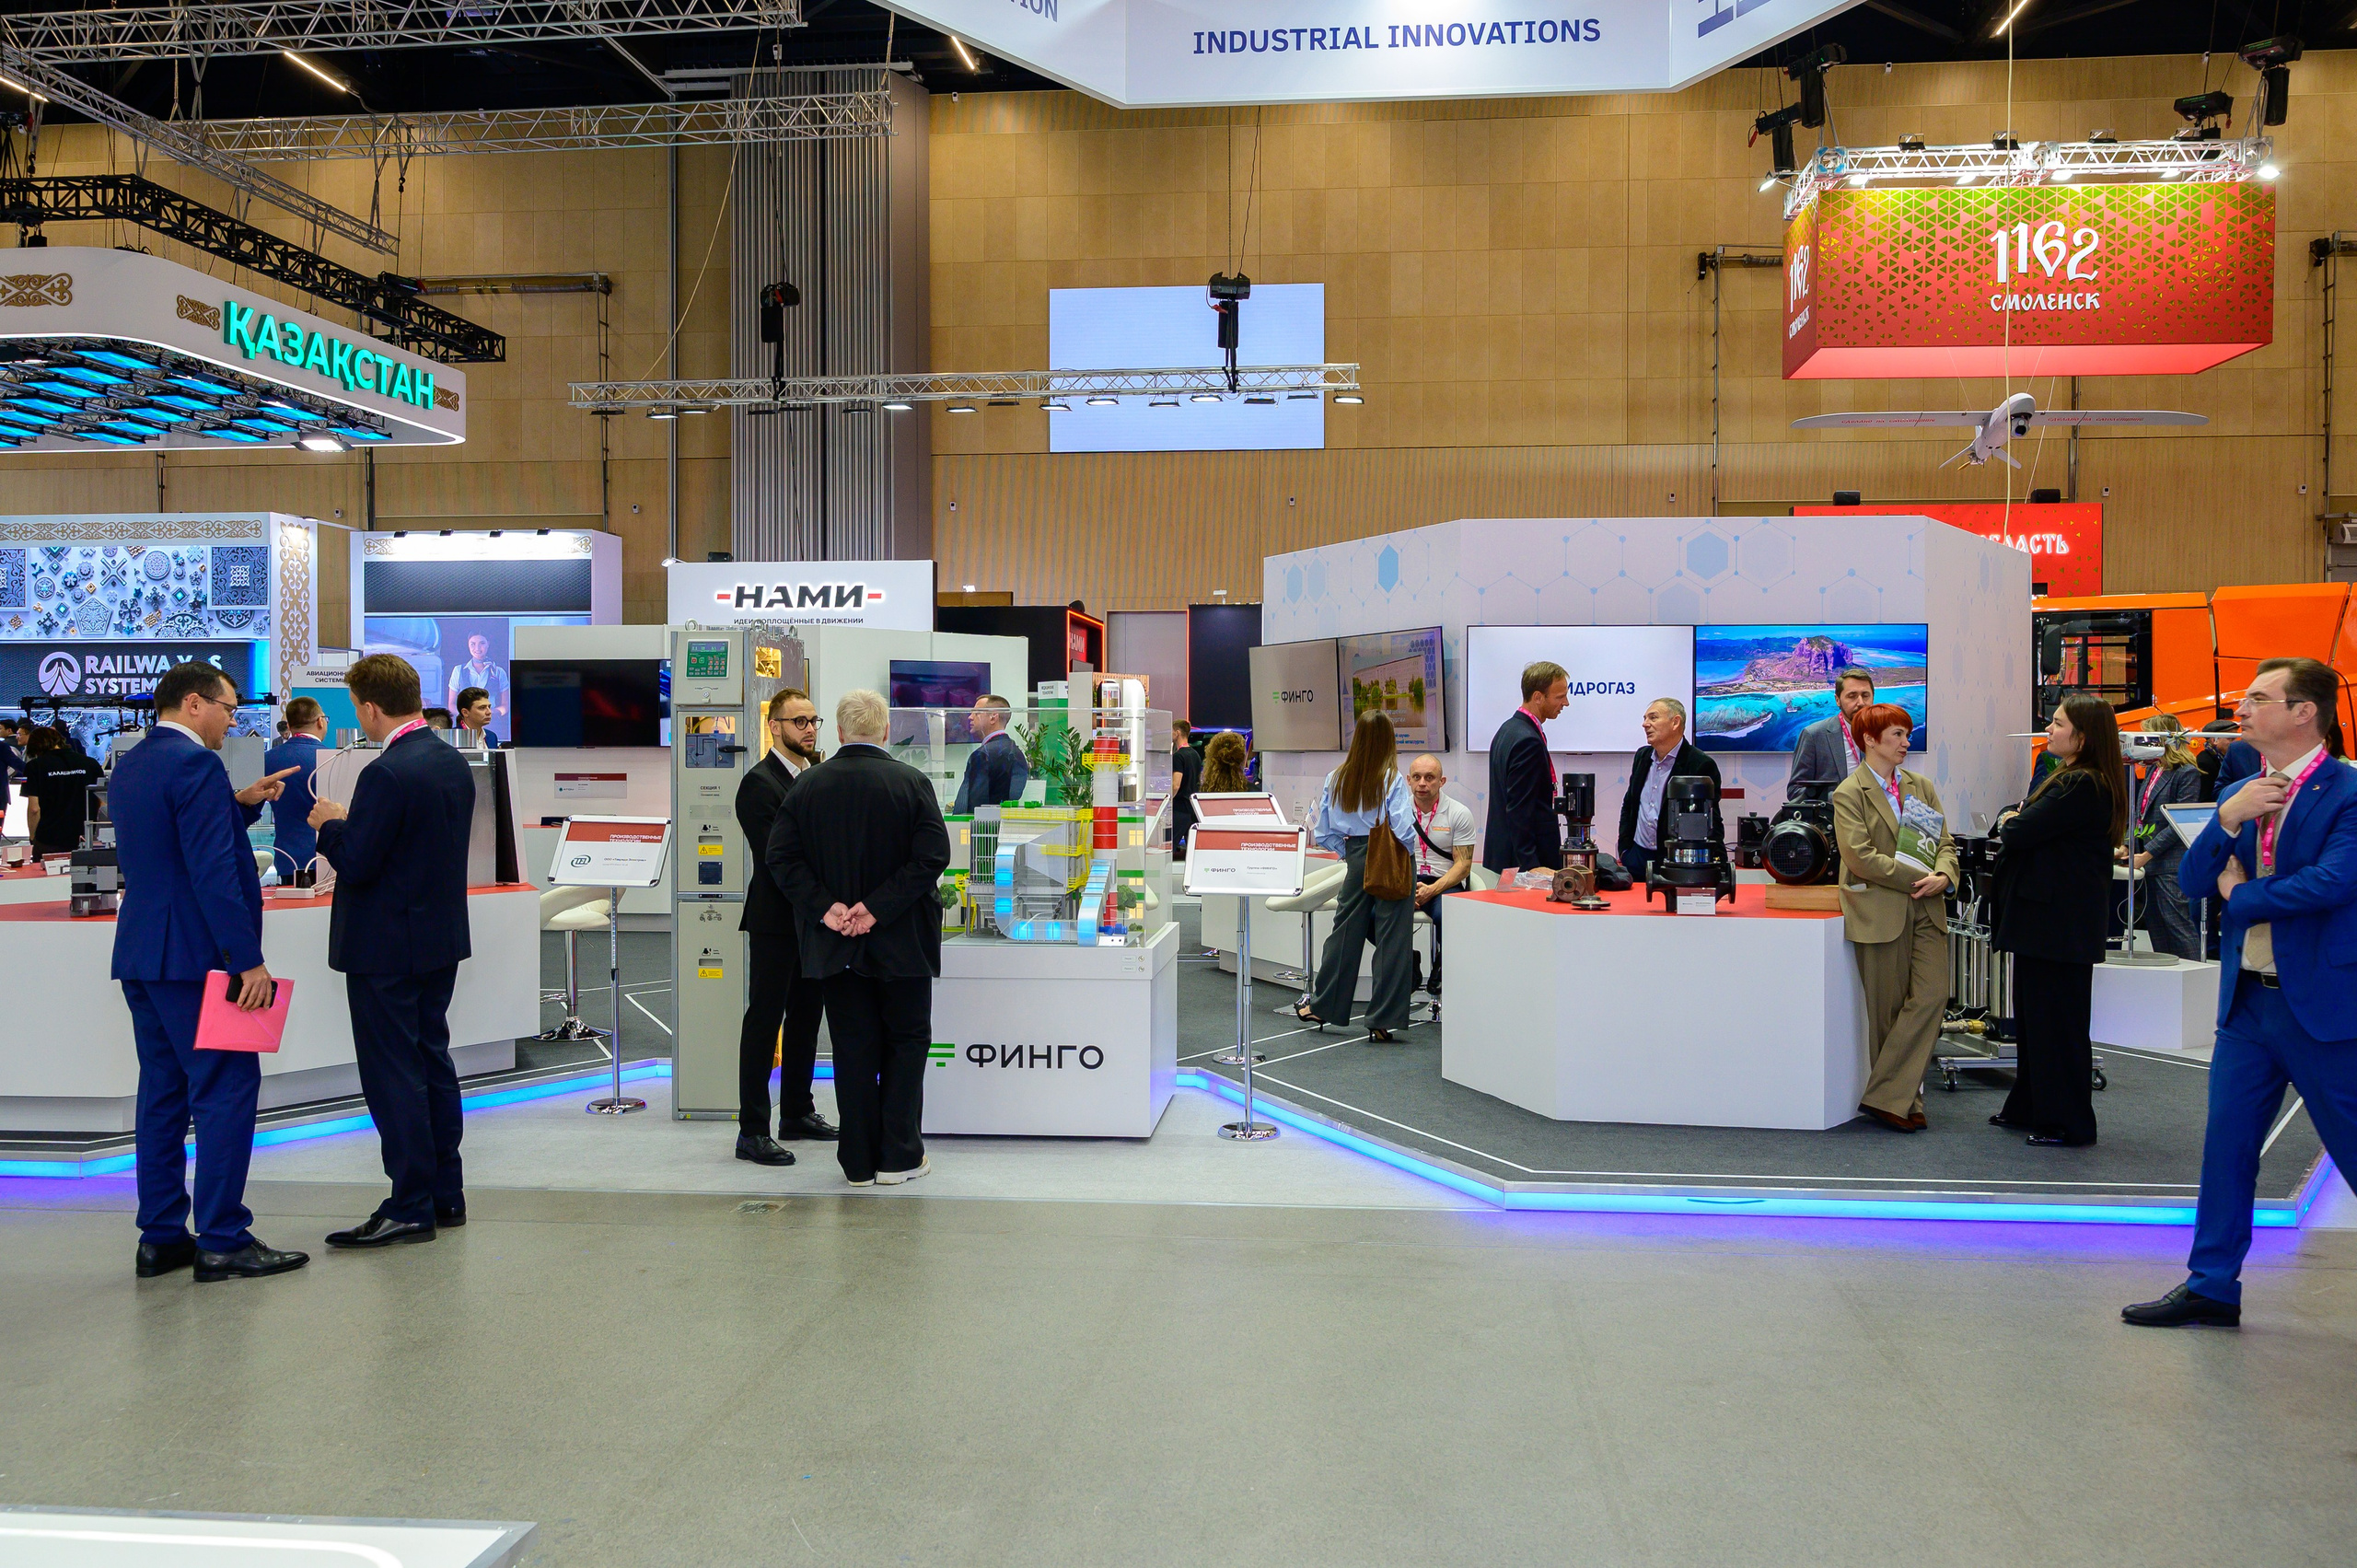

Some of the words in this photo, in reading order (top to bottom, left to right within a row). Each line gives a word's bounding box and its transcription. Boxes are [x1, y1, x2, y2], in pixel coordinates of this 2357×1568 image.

[1193, 26, 1379, 54] INDUSTRIAL
[1387, 17, 1602, 49] INNOVATIONS
[1990, 220, 2100, 284] 1162
[1789, 244, 1810, 314] 1162
[1990, 292, 2102, 312] СМОЛЕНСК
[223, 300, 435, 411] ҚАЗАҚСТАН
[735, 585, 865, 609] НАМИ
[85, 678, 163, 694] SYSTEM
[1281, 690, 1314, 703] ФИНГО
[966, 1044, 1105, 1070] ФИНГО
